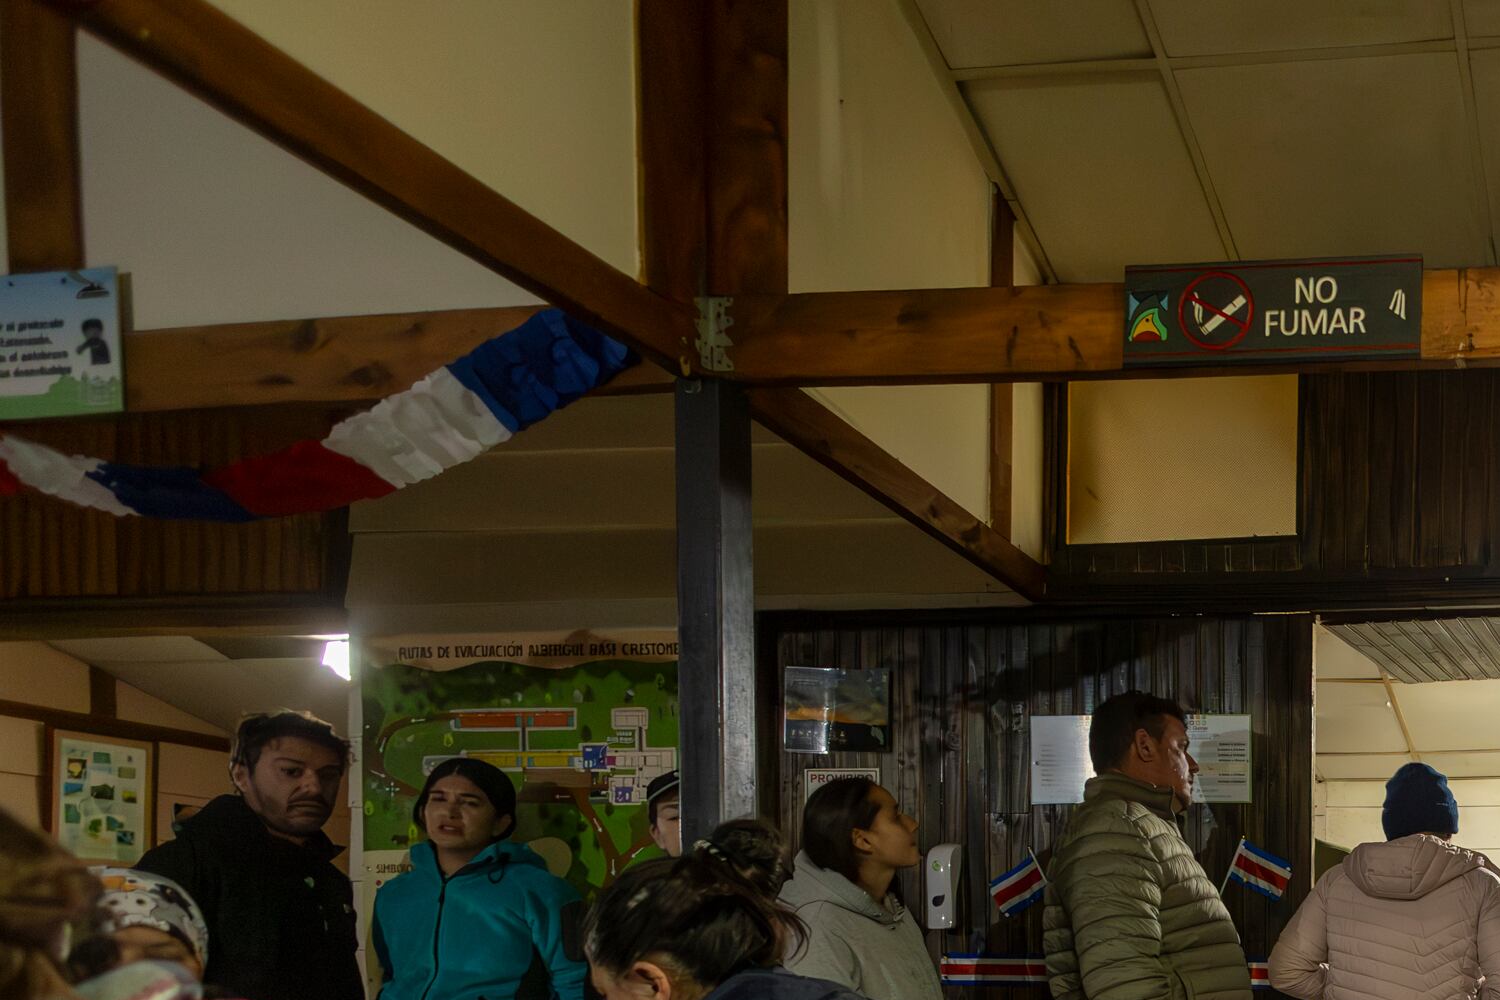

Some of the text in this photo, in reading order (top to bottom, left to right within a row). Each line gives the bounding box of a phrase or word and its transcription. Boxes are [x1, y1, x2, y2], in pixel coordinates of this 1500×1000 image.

[1294, 275, 1338, 304] NO
[1264, 307, 1366, 337] FUMAR
[399, 646, 432, 659] RUTAS
[437, 646, 450, 659] DE
[455, 640, 523, 658] EVACUACIÓN
